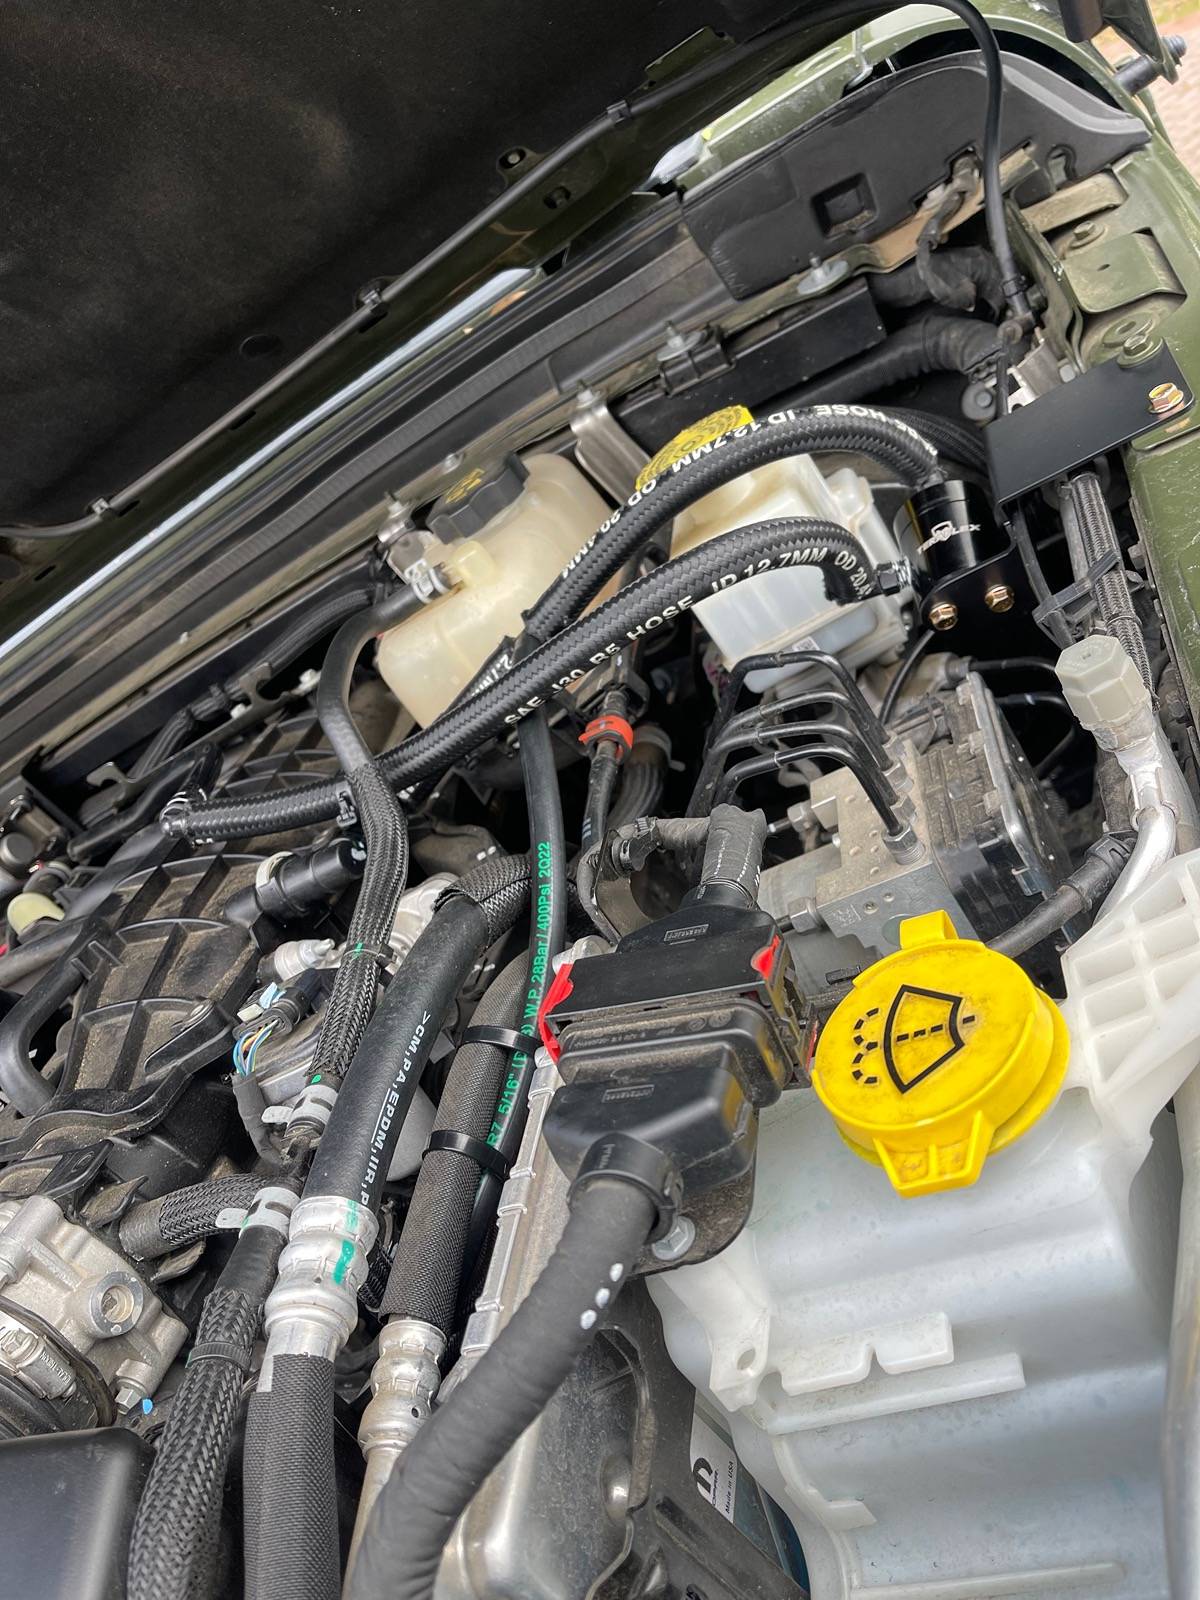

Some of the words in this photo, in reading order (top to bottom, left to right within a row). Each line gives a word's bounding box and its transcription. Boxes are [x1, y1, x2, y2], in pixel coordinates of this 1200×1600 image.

[767, 409, 797, 424] ID
[813, 404, 887, 423] HOSE
[671, 420, 762, 473] 12.7MM
[628, 479, 657, 506] OD
[504, 696, 544, 724] SAE
[551, 669, 586, 694] J30
[589, 643, 621, 664] R5
[626, 595, 694, 640] HOSE
[711, 573, 738, 593] ID
[744, 547, 828, 577] 12.7MM
[834, 550, 857, 571] OD
[486, 1121, 502, 1147] R7
[524, 986, 542, 1019] W.P.
[538, 841, 551, 879] 2Q22
